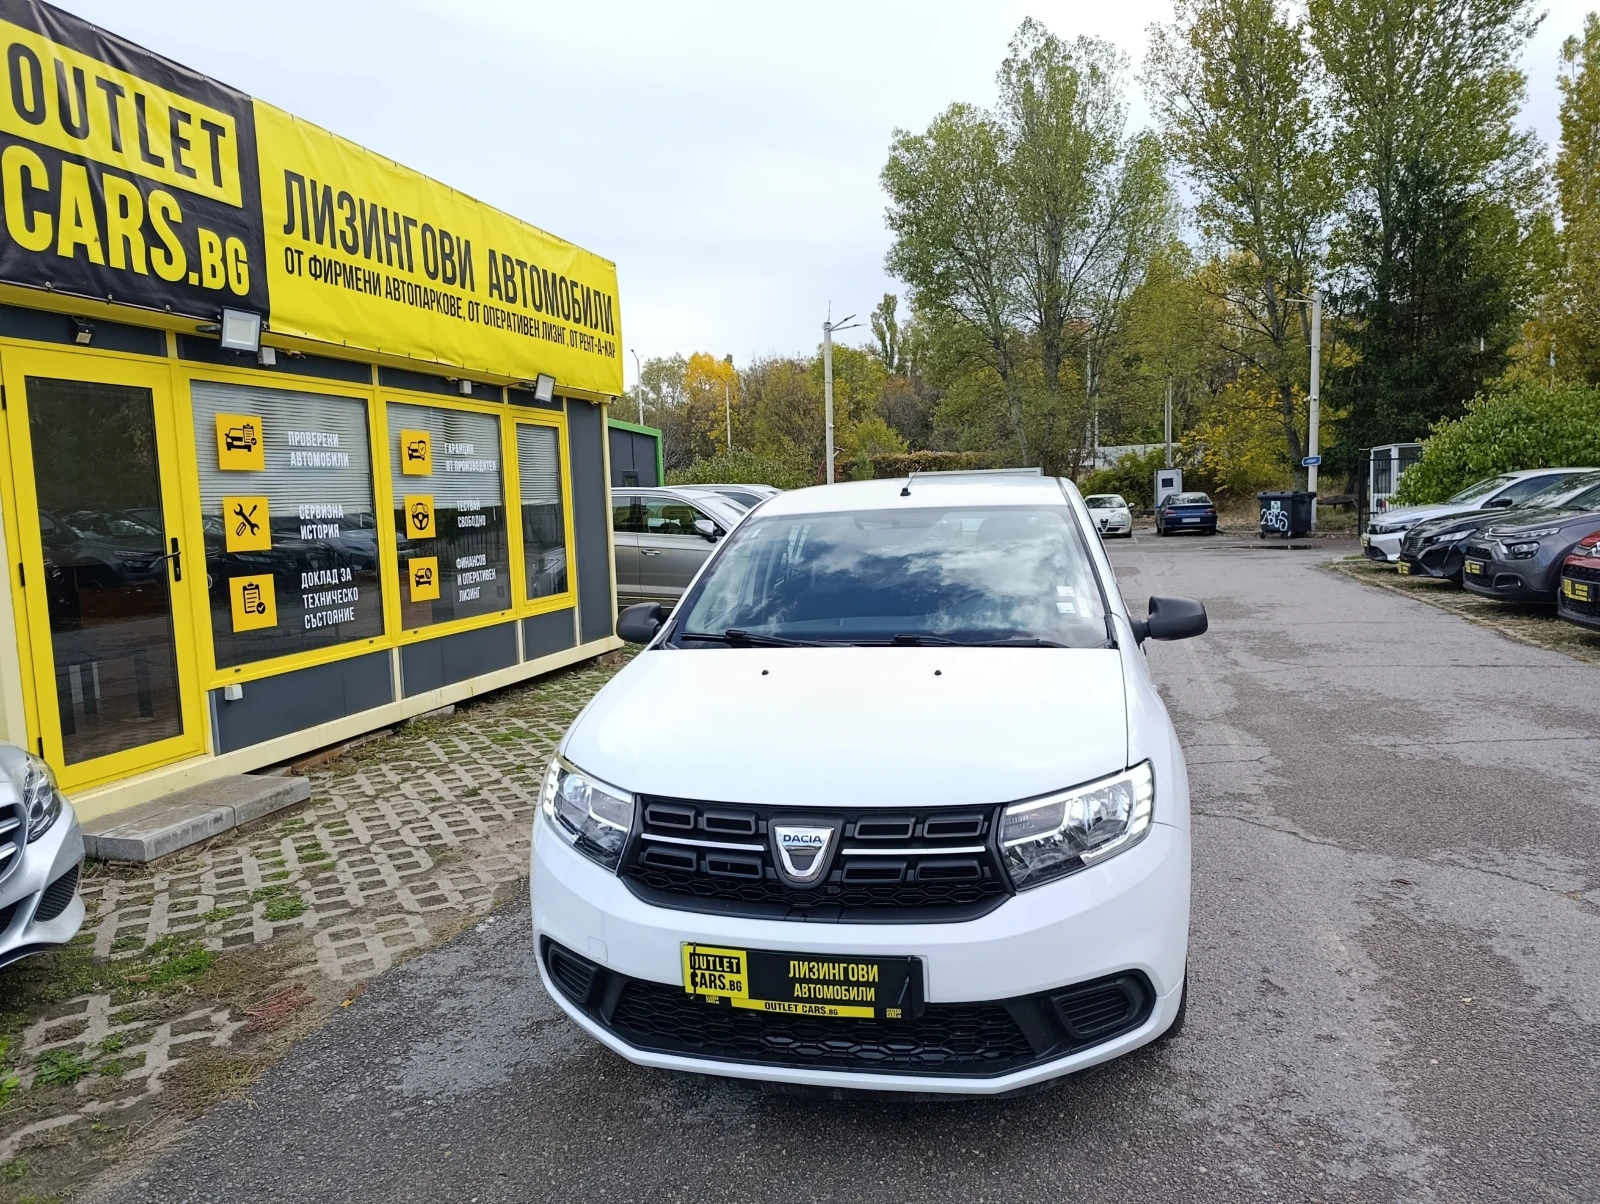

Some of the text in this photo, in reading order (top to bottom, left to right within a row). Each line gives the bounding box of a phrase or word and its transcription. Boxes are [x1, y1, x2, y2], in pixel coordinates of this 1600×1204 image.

[7, 42, 226, 190] OUTLET
[1, 145, 250, 296] CARS.BG
[283, 168, 615, 337] ЛИЗИНГОВИ АВТОМОБИЛИ
[284, 246, 304, 277] ОТ
[308, 254, 382, 298] ФИРМЕНИ
[385, 275, 466, 323] АВТОПАРКОВЕ,
[468, 300, 480, 323] ОТ
[483, 304, 540, 339] ОПЕРАТИВЕН
[570, 329, 578, 349] ОТ
[288, 431, 339, 448] ПРОВЕРЕНИ
[290, 452, 350, 467] АВТОМОБИЛИ
[299, 504, 344, 520] СЕРВИЗНА
[457, 498, 481, 512] ТЕСТВАЙ
[457, 515, 486, 528] СВОБОДНО
[300, 523, 340, 540] ИСТОРИЯ
[456, 554, 487, 569] ФИНАНСОВ
[301, 567, 353, 589] ДОКЛАД ЗА
[457, 568, 497, 586] И ОПЕРАТИВЕН
[302, 586, 359, 609] ТЕХНИЧЕСКО
[458, 586, 481, 602] ЛИЗИНГ
[304, 607, 355, 629] СЪСТОЯНИЕ
[783, 834, 822, 844] DACIA
[691, 955, 738, 973] OUTLET
[788, 960, 879, 983] ЛИЗИНГОВИ
[690, 971, 743, 992] CARS.BG
[793, 982, 876, 1002] АВТОМОБИЛИ
[764, 1001, 839, 1016] OUTLET CARS.BG
